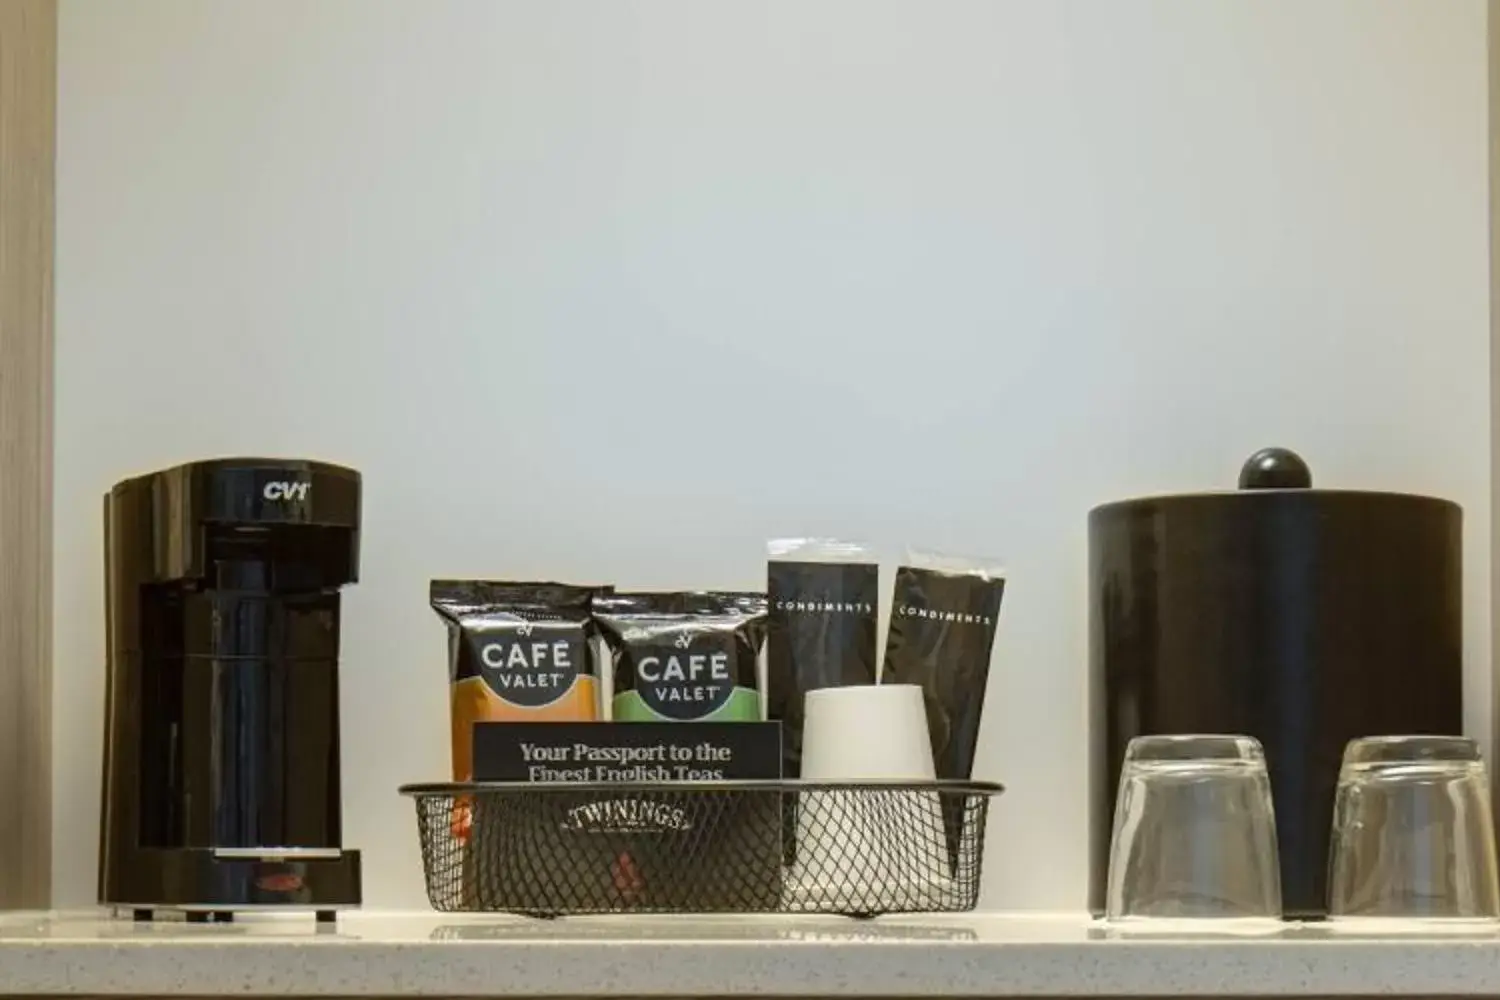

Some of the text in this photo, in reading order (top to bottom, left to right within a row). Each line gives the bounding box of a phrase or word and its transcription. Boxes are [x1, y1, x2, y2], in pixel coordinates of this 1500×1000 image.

[776, 600, 873, 614] CONDIMENTS
[898, 604, 992, 626] CONDIMENTS
[499, 672, 561, 689] VALET
[655, 686, 718, 701] VALET
[519, 742, 732, 766] Your Passport to the
[527, 765, 591, 782] Finest
[568, 799, 686, 830] TWININGS
